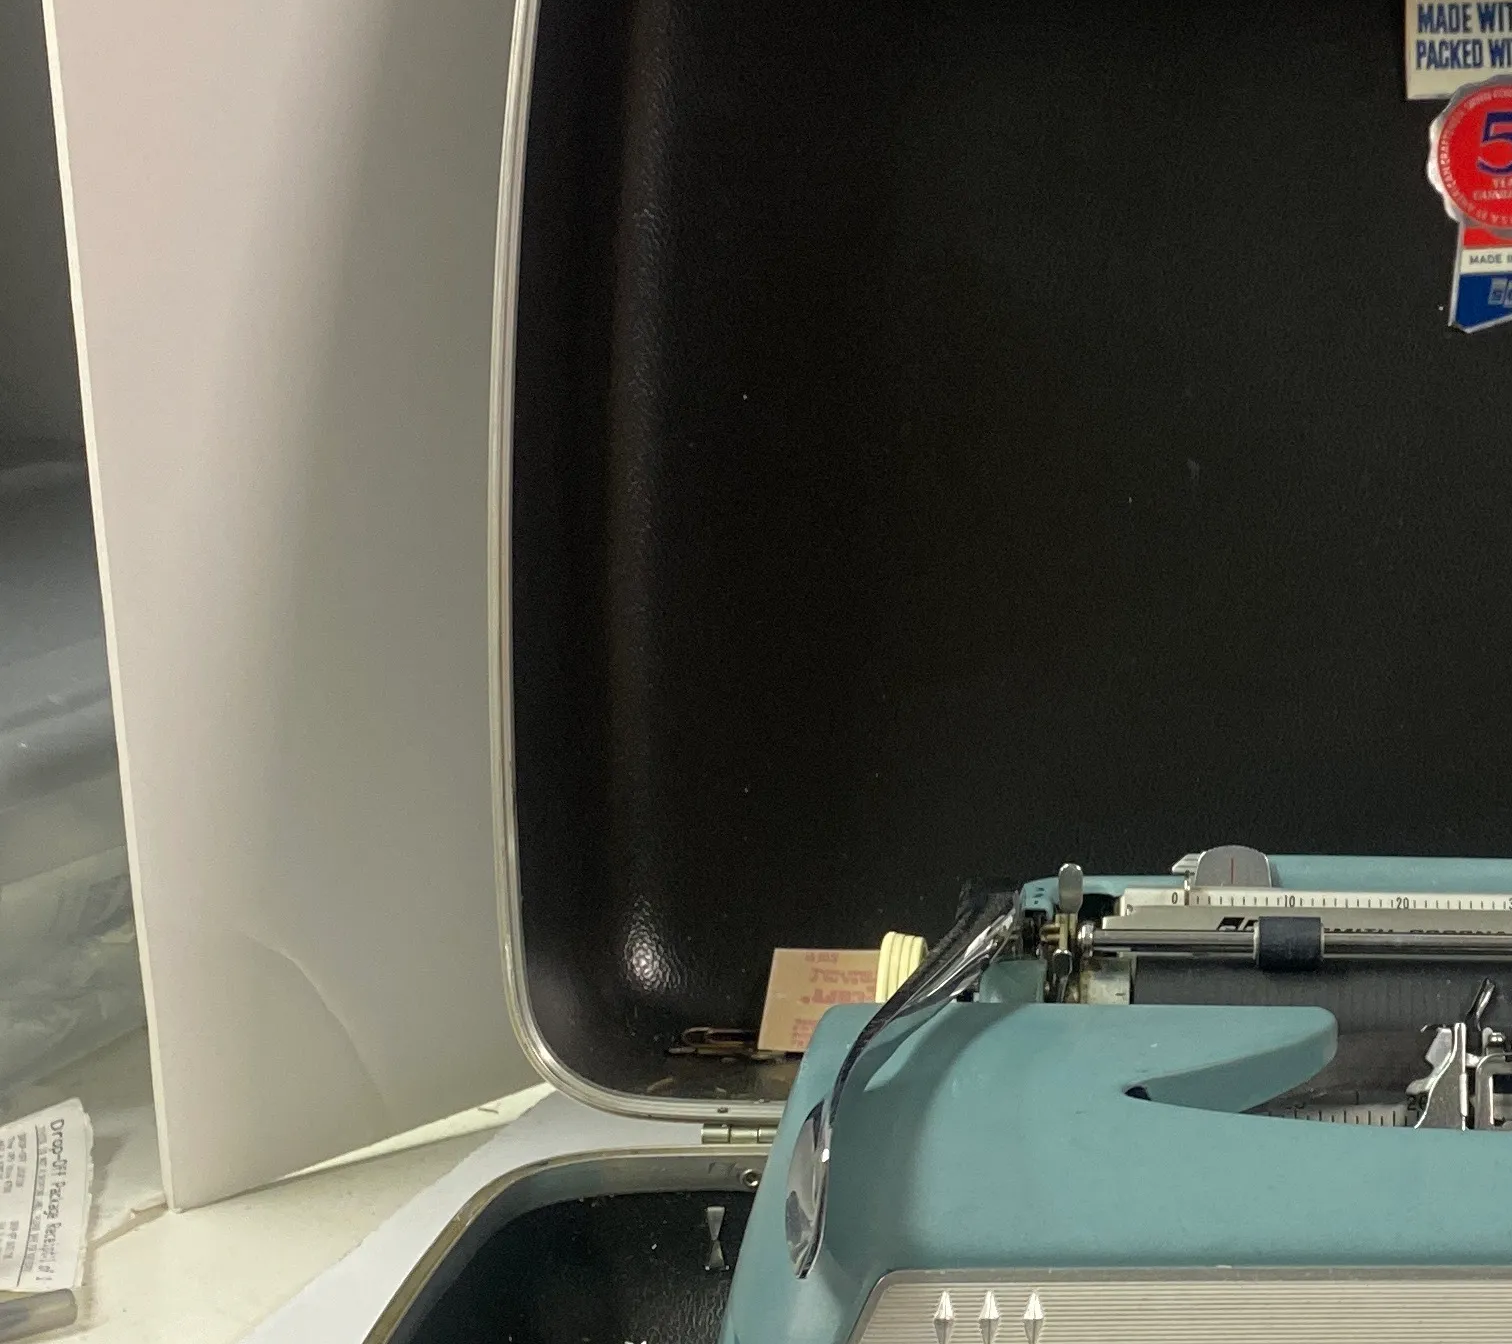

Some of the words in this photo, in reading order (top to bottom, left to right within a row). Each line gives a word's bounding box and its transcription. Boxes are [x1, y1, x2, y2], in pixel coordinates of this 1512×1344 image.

[1416, 2, 1472, 34] MADE
[1415, 38, 1484, 70] PACKED
[1469, 254, 1502, 265] MADE
[1171, 891, 1179, 905] 0
[1284, 894, 1296, 908] 10
[1396, 897, 1409, 910] 20
